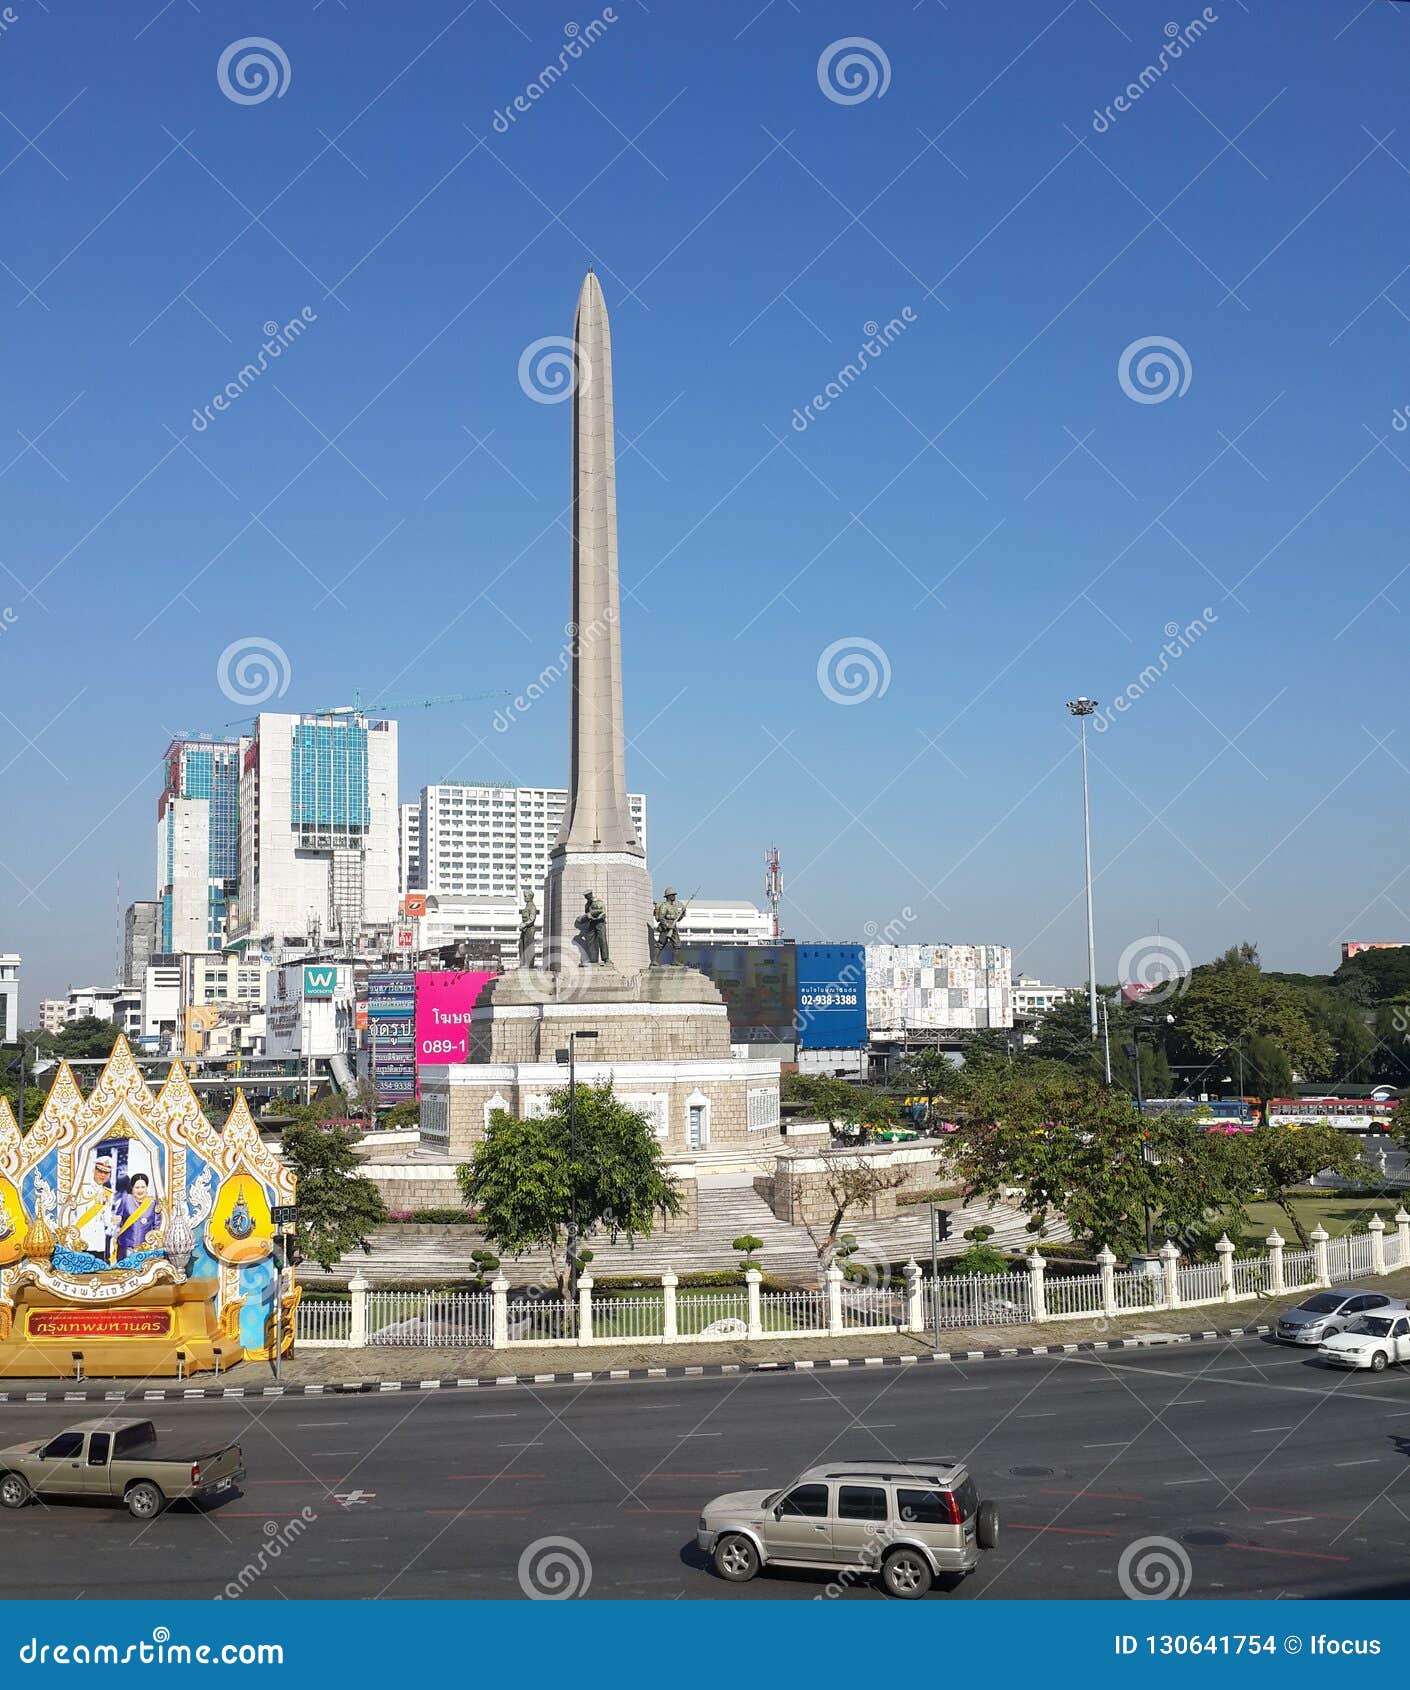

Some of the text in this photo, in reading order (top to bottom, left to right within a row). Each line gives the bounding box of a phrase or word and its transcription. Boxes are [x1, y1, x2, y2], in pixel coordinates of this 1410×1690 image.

[801, 994, 857, 1006] 02-938-3388
[422, 1039, 466, 1054] 089-1
[52, 1278, 139, 1298] ทรงพระเจริญ
[37, 1321, 161, 1335] กรุงเทพมหานคร
